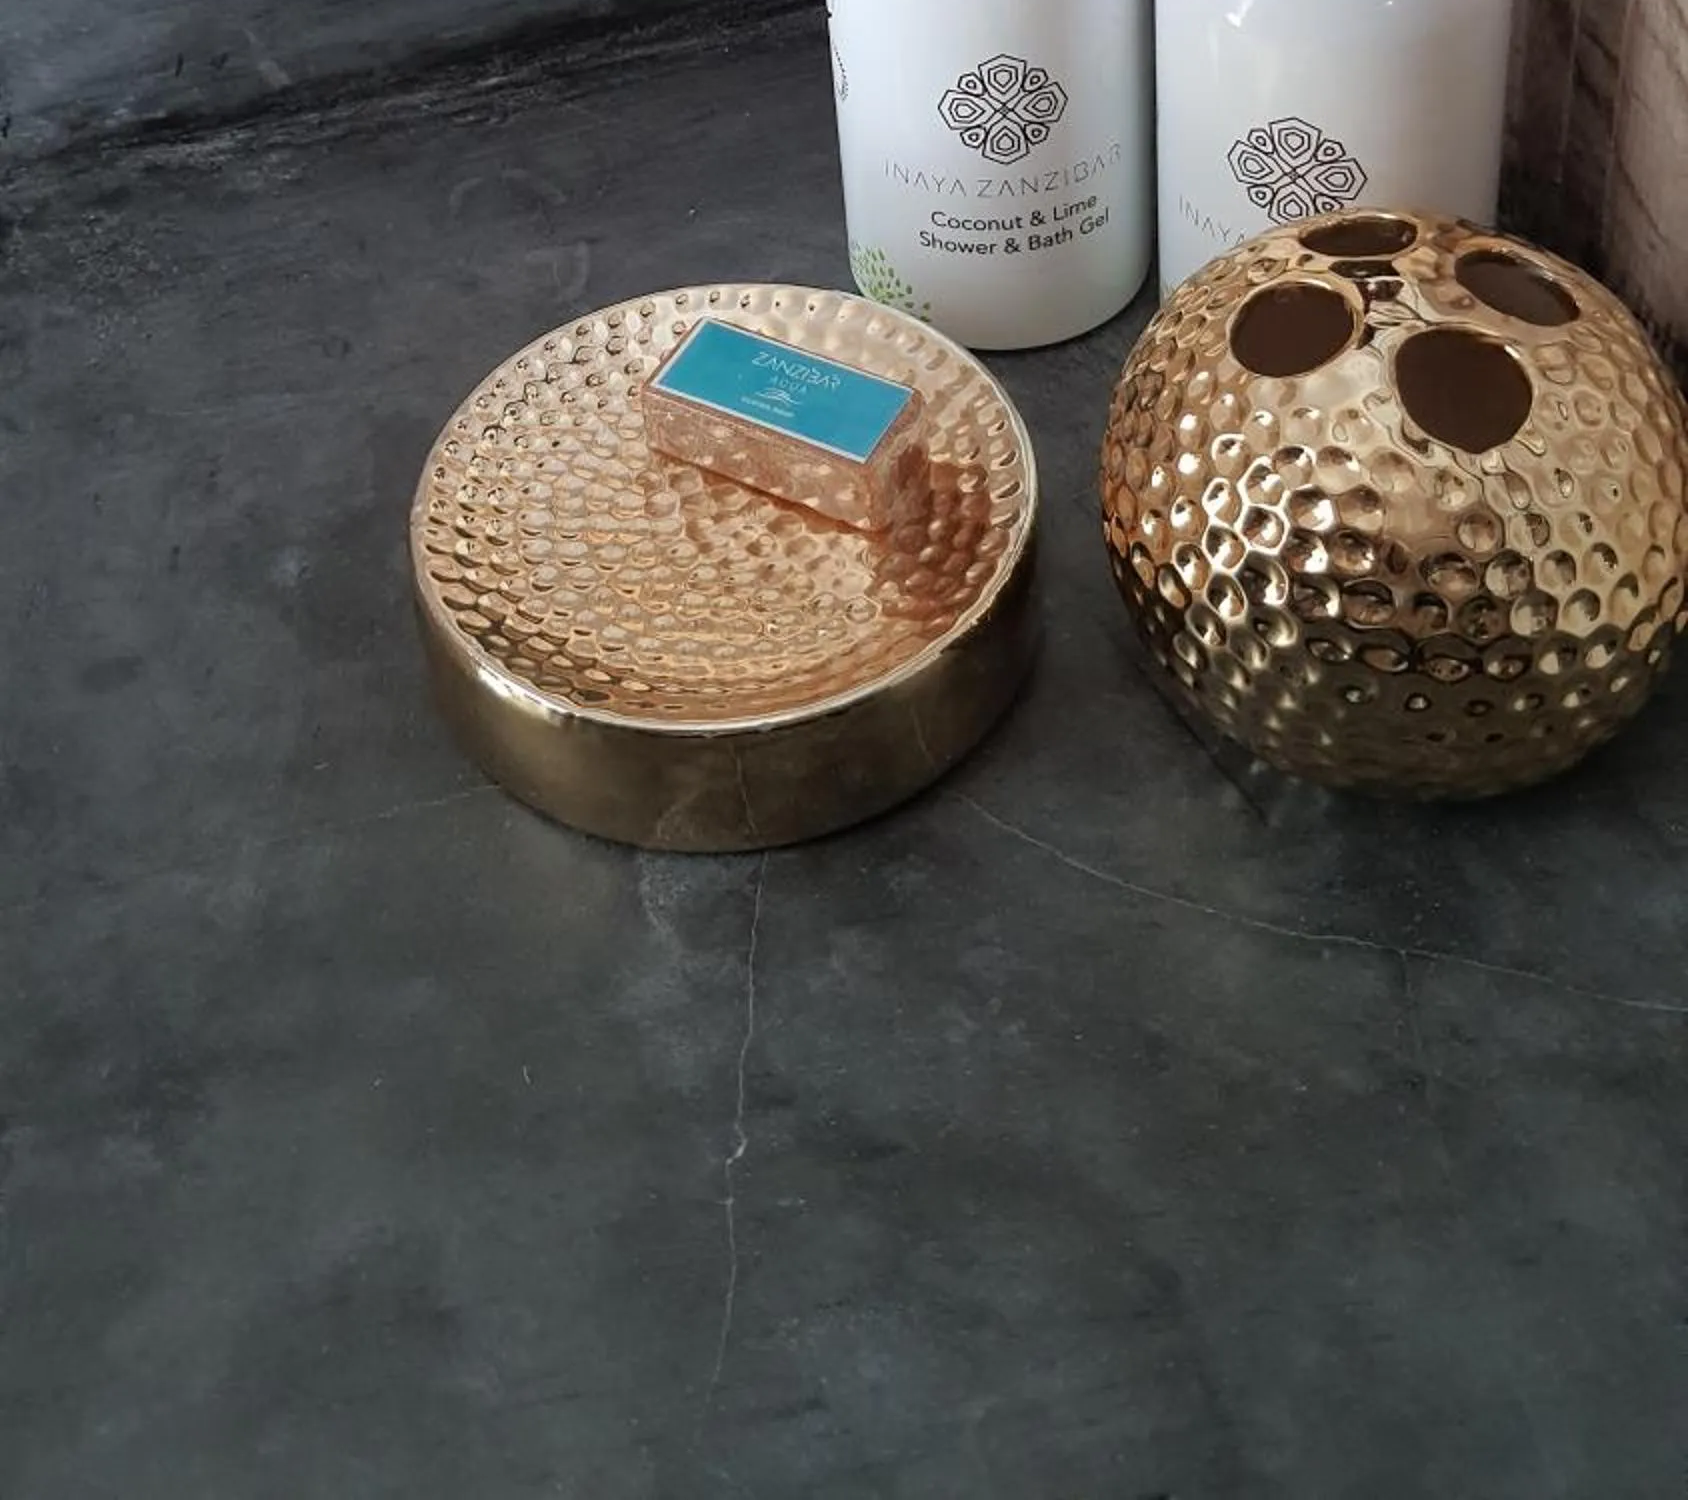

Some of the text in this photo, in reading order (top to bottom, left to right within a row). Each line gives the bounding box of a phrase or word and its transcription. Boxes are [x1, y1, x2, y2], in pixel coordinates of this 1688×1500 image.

[884, 142, 1122, 198] INAYA ZANZIBAR
[919, 208, 1110, 255] Shower & Bath Gel
[930, 194, 1098, 231] Coconut & Lime
[751, 351, 841, 391] ZANZIBAR
